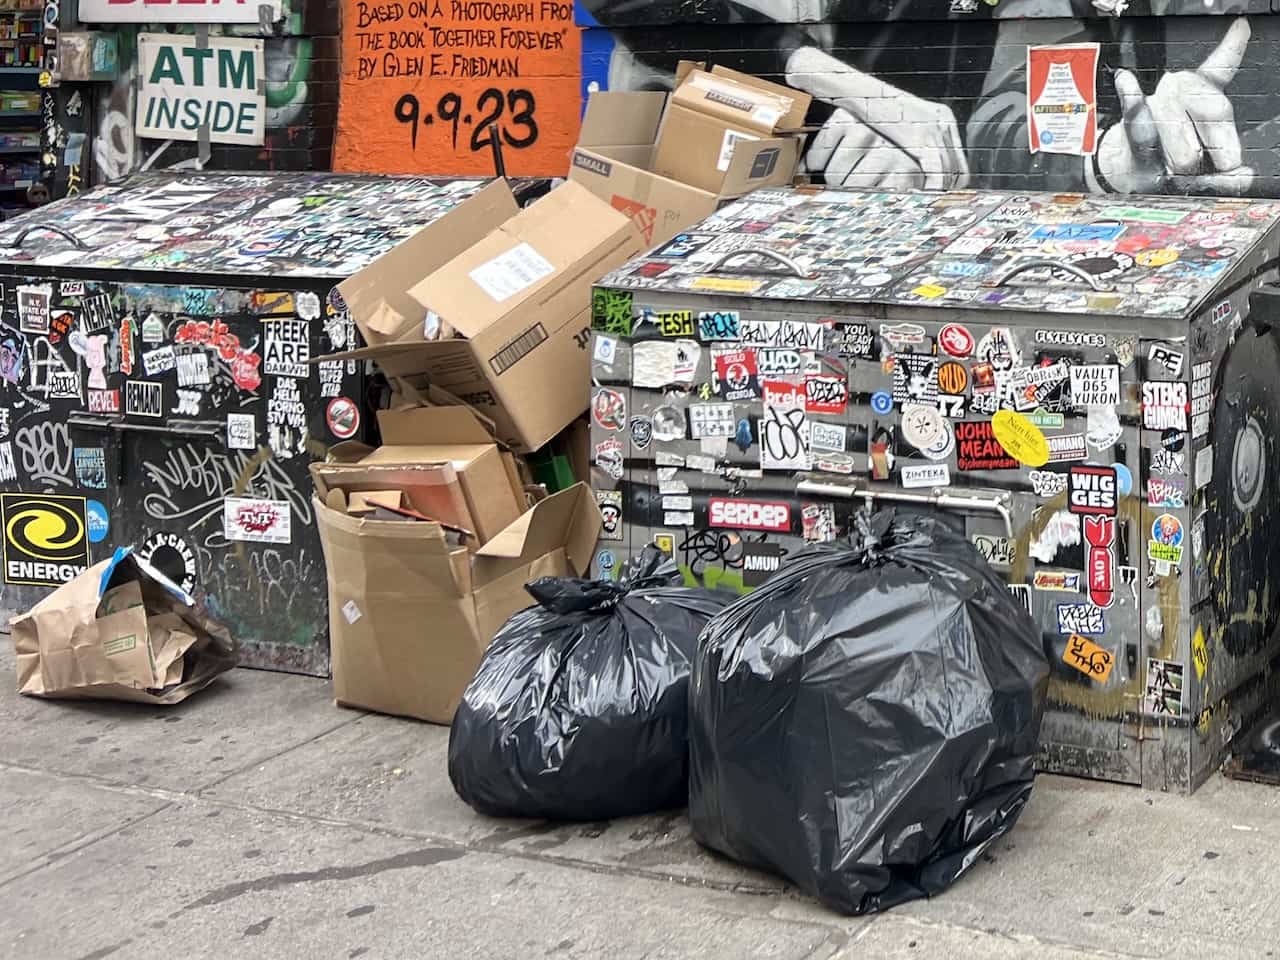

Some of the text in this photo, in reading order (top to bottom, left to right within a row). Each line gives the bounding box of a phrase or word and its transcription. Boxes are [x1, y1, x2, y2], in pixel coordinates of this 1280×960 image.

[357, 2, 403, 28] BASED
[408, 0, 428, 19] ON
[431, 0, 444, 18] A
[450, 0, 533, 21] PHOTOGRAPH
[356, 32, 384, 51] THE
[390, 30, 425, 50] BOOK
[148, 46, 256, 90] ATM
[358, 52, 518, 80] BY GLEN E. FRIEDMAN
[144, 97, 257, 135] INSIDE
[394, 88, 539, 152] 9.9.23
[575, 155, 609, 176] SMALL
[844, 324, 866, 335] YOU
[1075, 367, 1114, 380] VAULT
[1074, 393, 1117, 405] YUKON
[1072, 473, 1115, 489] WIG
[1071, 491, 1115, 507] GES
[8, 560, 88, 582] ENERGY
